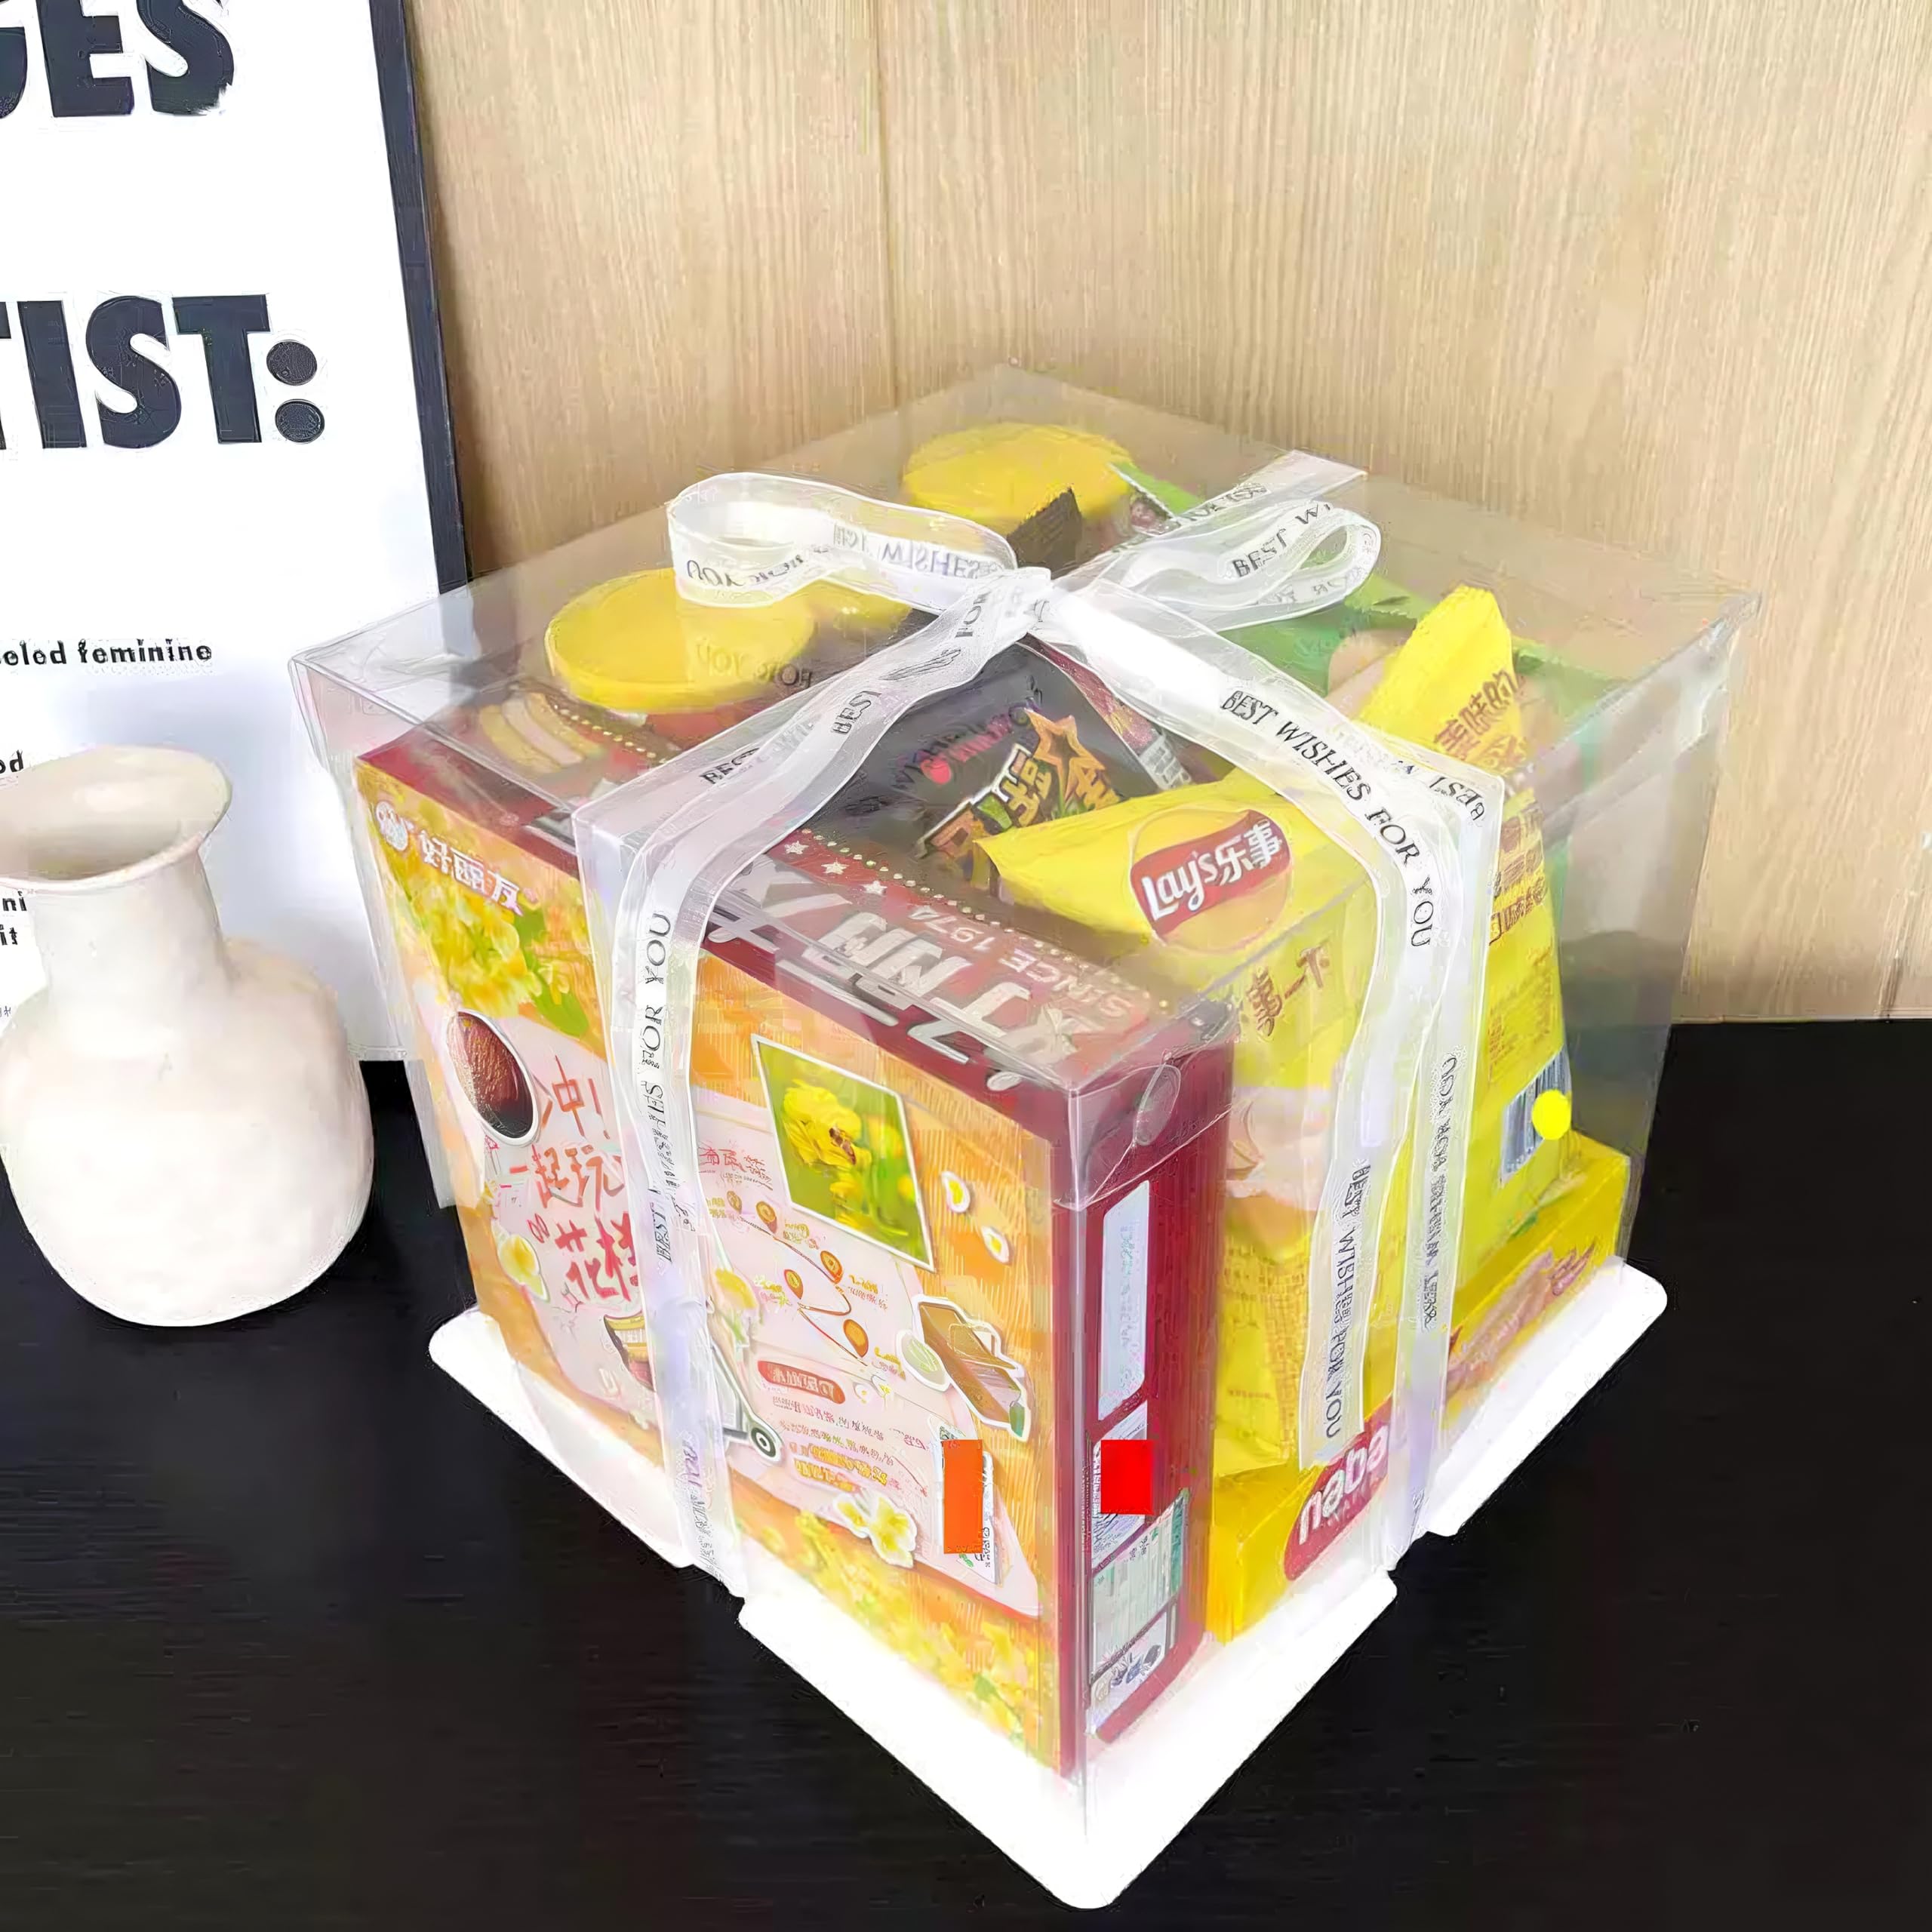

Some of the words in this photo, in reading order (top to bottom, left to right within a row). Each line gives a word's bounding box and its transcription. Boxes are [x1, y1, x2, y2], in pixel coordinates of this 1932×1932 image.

[0, 294, 325, 451] IST:
[1220, 690, 1278, 726] BEST
[1275, 720, 1372, 802] WISHES
[1365, 807, 1420, 867] FOR
[420, 829, 524, 916] 好丽友
[1141, 850, 1218, 921] Lay's
[1214, 819, 1283, 886] 乐事
[645, 912, 672, 985] YOU
[909, 905, 996, 953] 1974
[1325, 1383, 1343, 1438] YOU
[1298, 1423, 1389, 1545] naba
